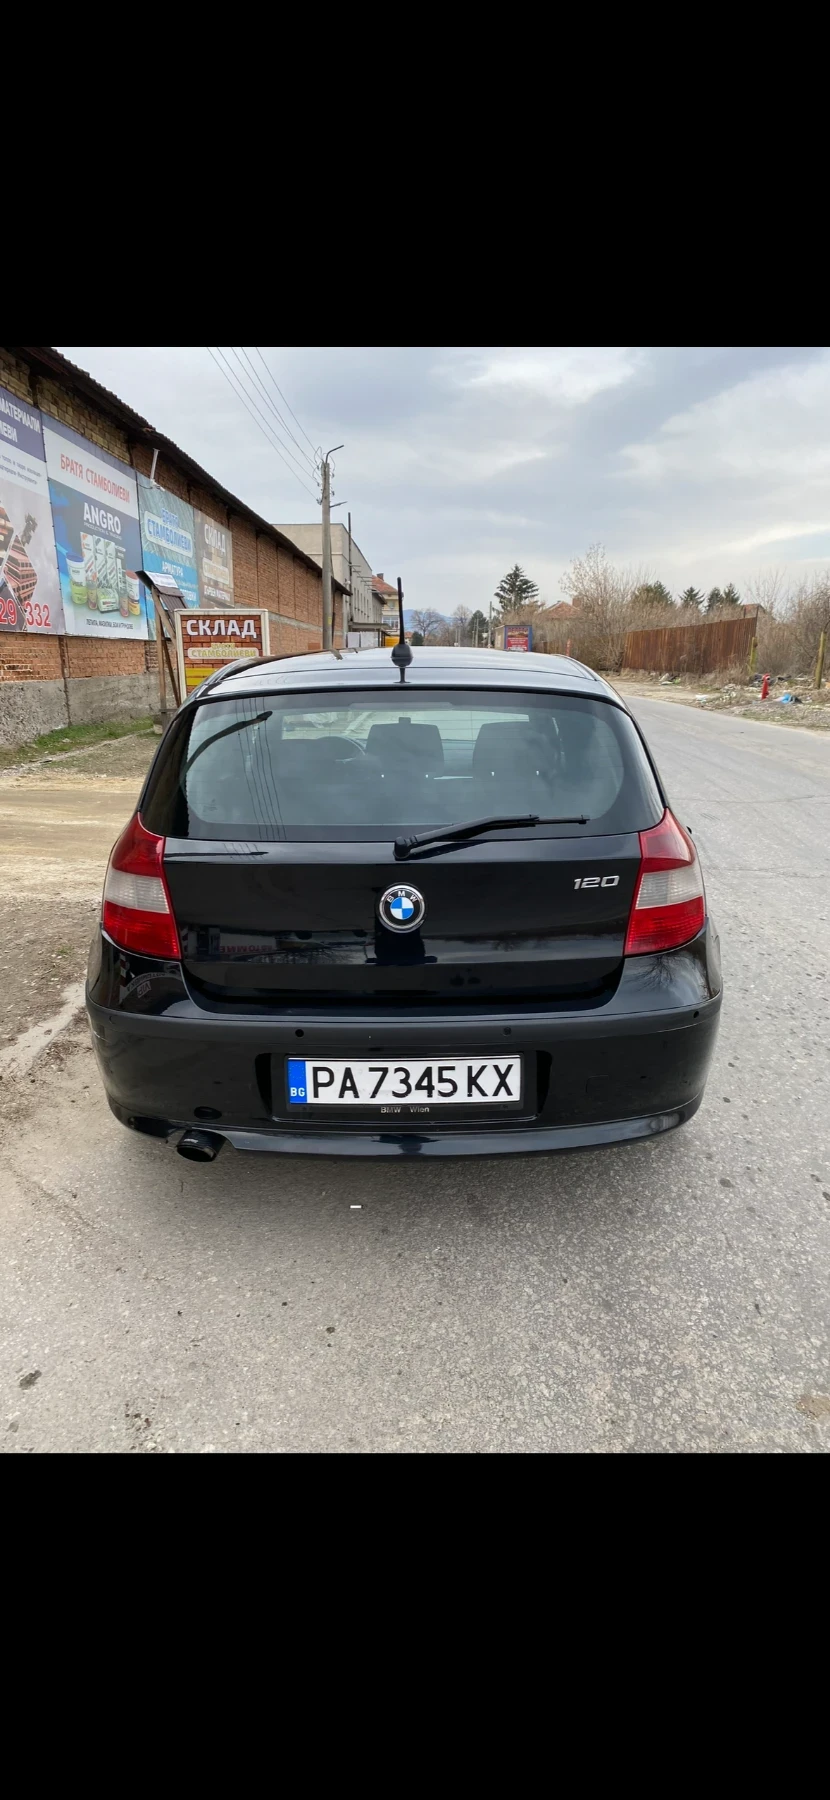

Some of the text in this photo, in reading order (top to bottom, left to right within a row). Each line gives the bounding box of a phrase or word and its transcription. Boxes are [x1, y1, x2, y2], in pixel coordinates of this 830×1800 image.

[60, 453, 83, 479] БРАТЯ
[85, 467, 131, 503] СТАМБОЛИЕВИ
[83, 501, 122, 535] ANGRO
[25, 600, 52, 629] 332
[186, 619, 257, 639] СКЛАД
[191, 649, 257, 658] СТАМБОЛИЕВИ
[573, 875, 620, 890] 120
[386, 890, 418, 903] BMW
[290, 1063, 514, 1099] BG PA 7345 KX
[381, 1106, 401, 1114] BMW
